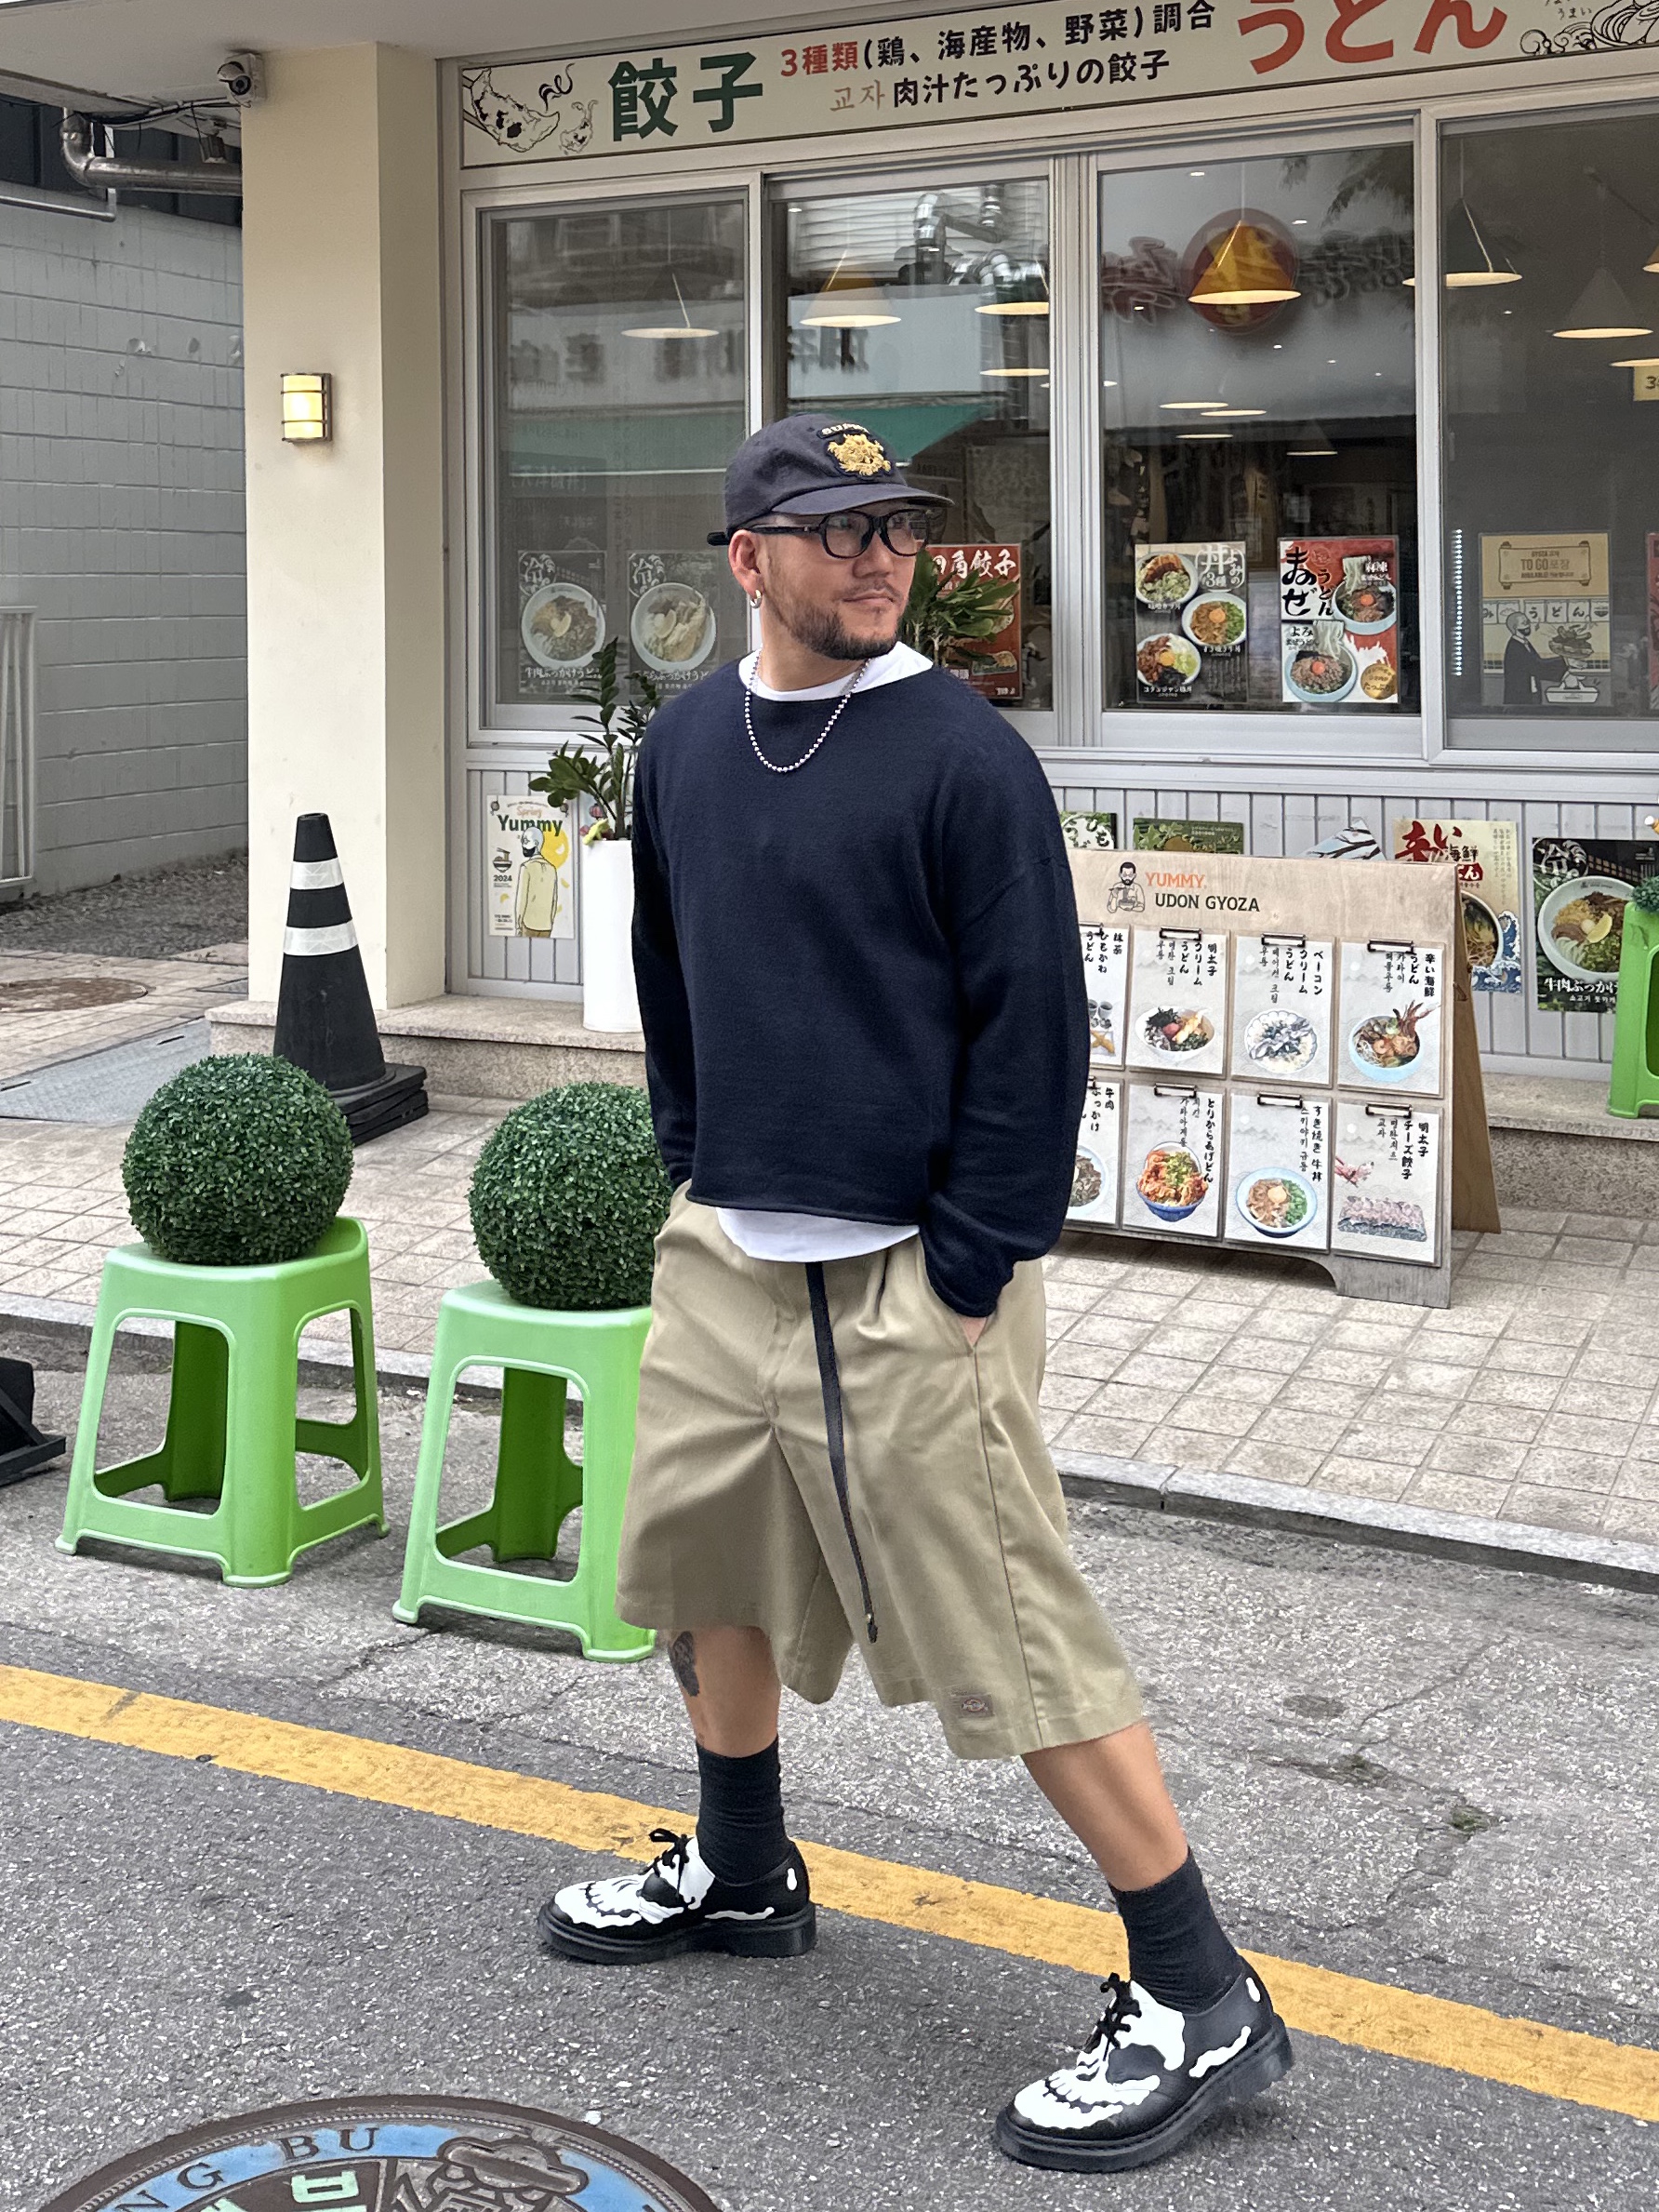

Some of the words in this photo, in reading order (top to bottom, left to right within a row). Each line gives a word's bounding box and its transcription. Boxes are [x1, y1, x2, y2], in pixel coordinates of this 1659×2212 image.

[607, 52, 763, 141] 餃子
[830, 78, 883, 113] 교자
[894, 49, 1170, 108] 肉汁たっぷりの餃子
[1520, 559, 1533, 570] TO
[1535, 559, 1548, 570] GO
[498, 814, 563, 836] Yummy
[1145, 872, 1206, 889] YUMMY
[1155, 893, 1200, 910] UDON
[1205, 896, 1260, 913] GYOZA
[1179, 940, 1189, 974] うどん
[1284, 947, 1294, 981] うどん
[1409, 953, 1419, 985] うどん
[282, 2126, 379, 2164] BU
